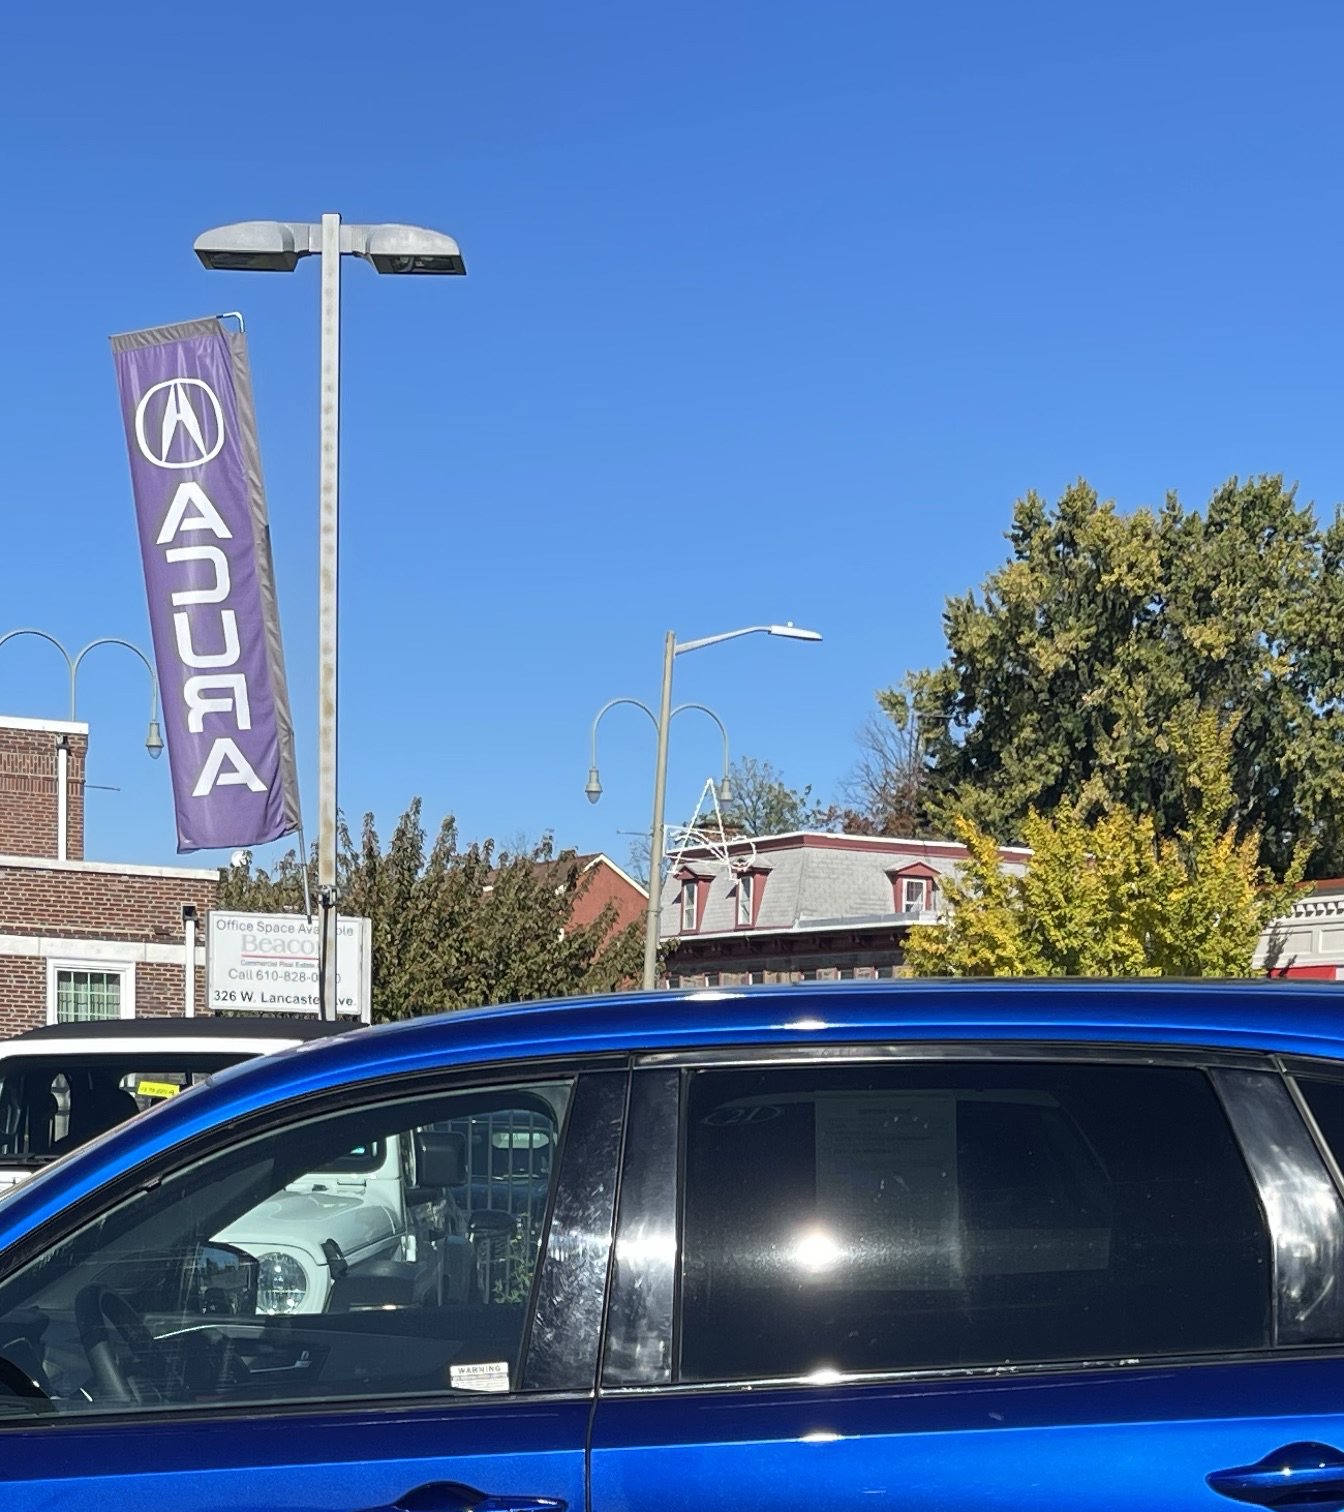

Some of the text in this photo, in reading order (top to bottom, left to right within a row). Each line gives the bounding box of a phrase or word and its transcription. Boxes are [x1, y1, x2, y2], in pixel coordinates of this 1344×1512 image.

[216, 919, 354, 937] Office Space Avable
[241, 933, 319, 955] Beaco
[228, 968, 342, 984] Call 610-828-00
[215, 990, 236, 1002] 326
[260, 992, 320, 1005] Lancaste
[457, 1364, 502, 1375] WARNING
